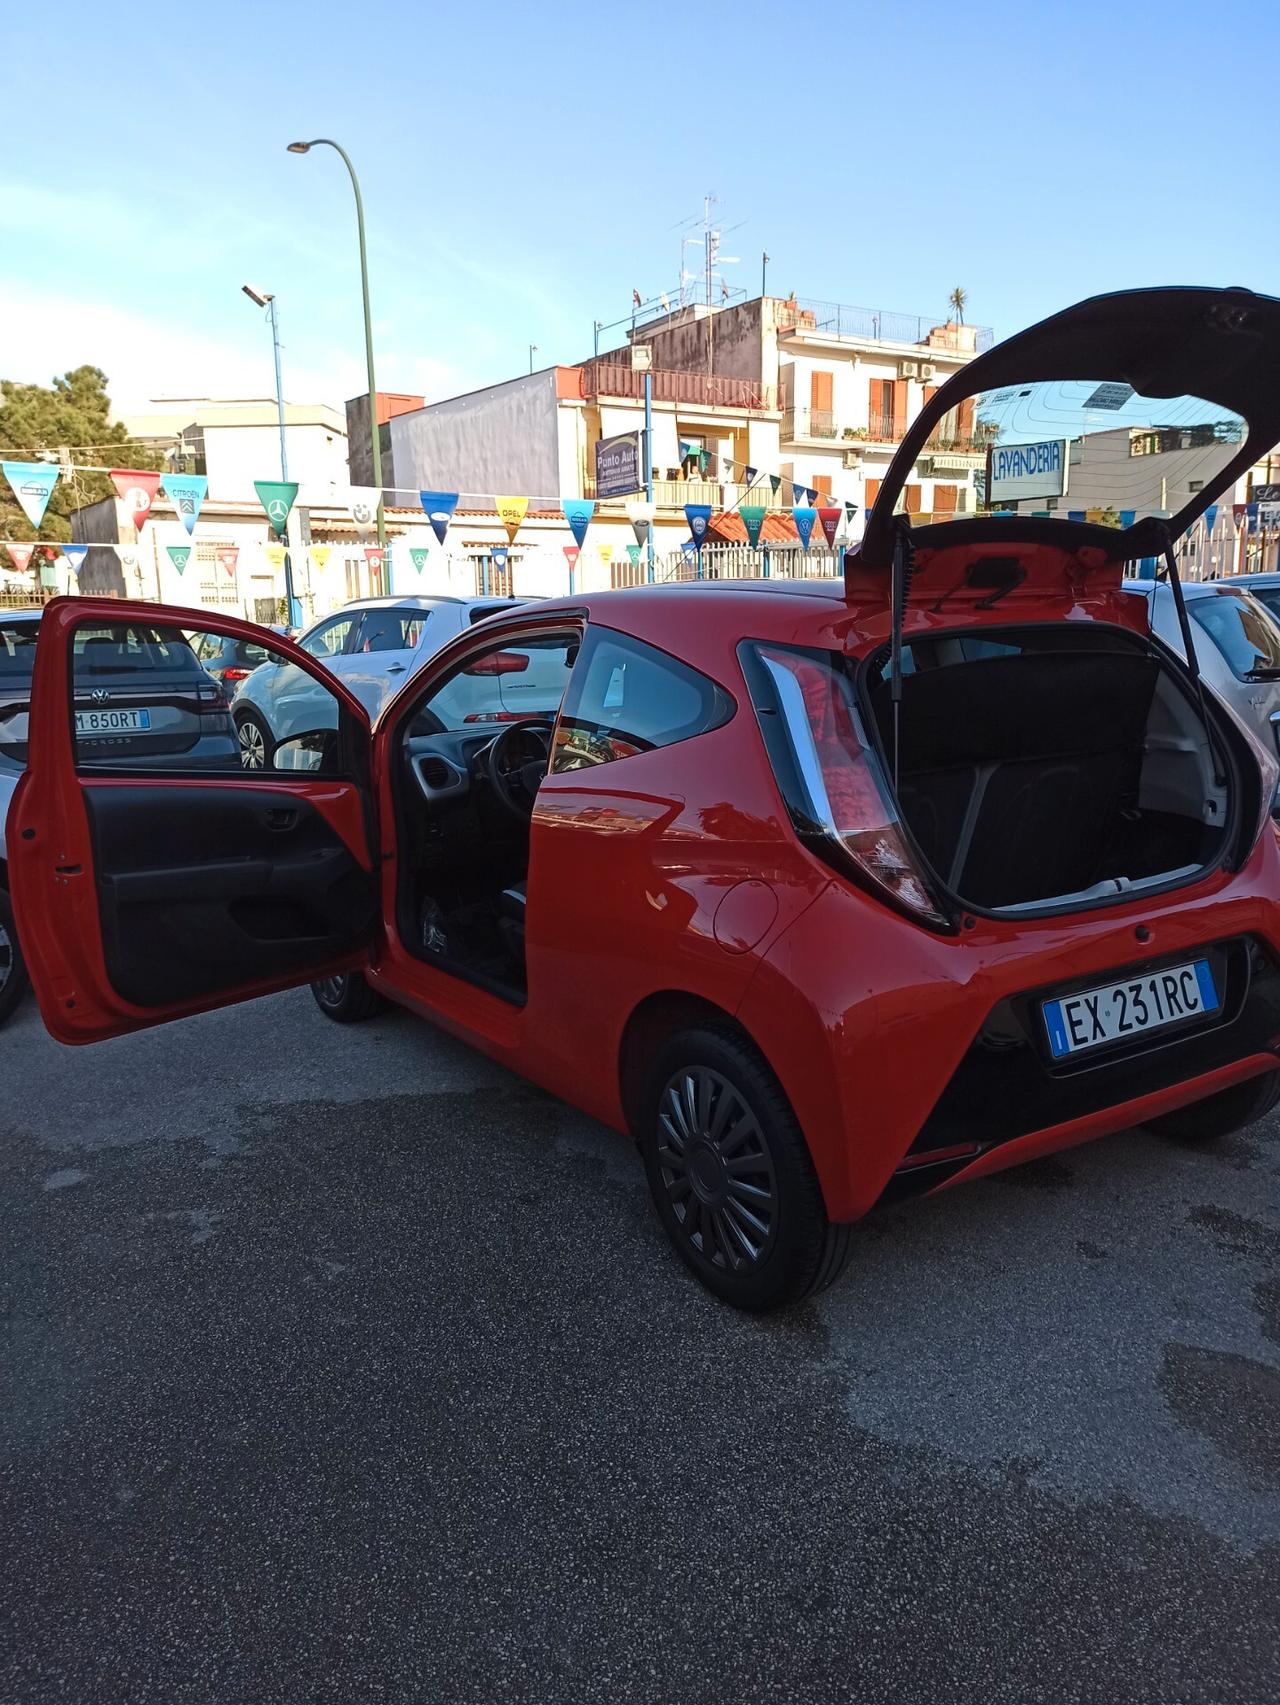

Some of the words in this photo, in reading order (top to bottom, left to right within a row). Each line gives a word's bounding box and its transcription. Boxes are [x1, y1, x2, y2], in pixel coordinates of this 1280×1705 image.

[597, 454, 620, 469] Punto
[621, 448, 638, 464] Auto
[993, 442, 1060, 481] LAVANDERIA
[502, 509, 521, 518] OPEL
[90, 711, 137, 729] 850RT
[1065, 995, 1107, 1046] EX
[1112, 970, 1199, 1033] 231RC
